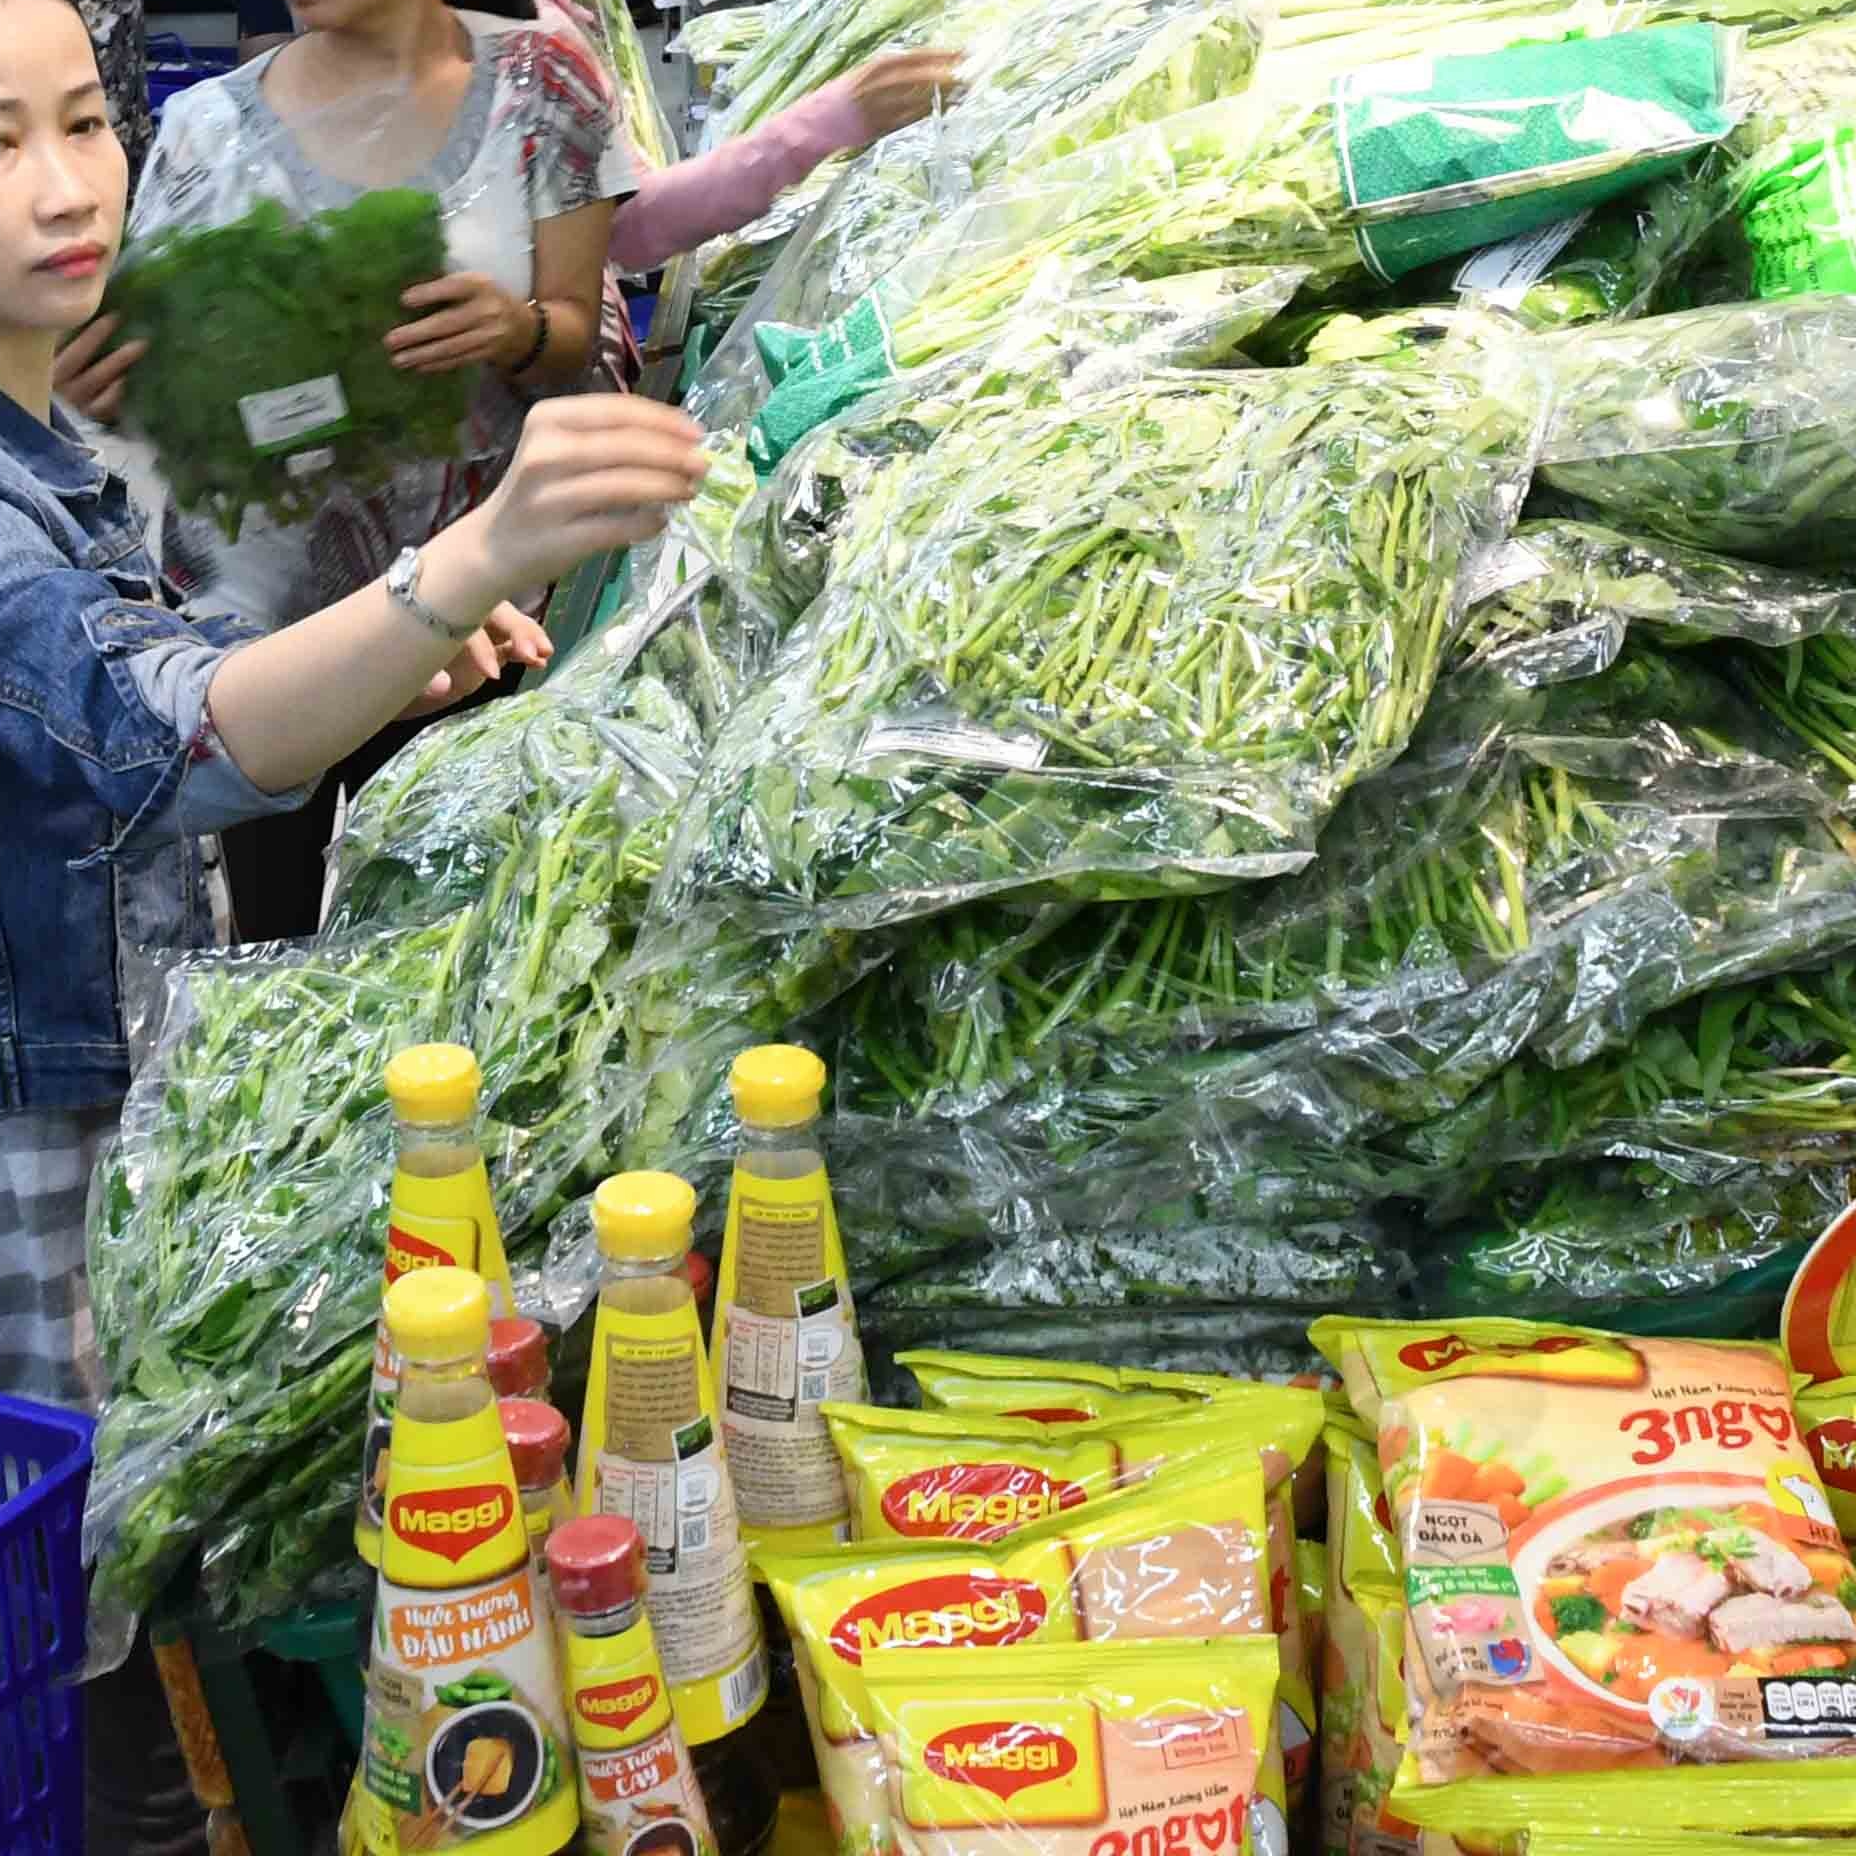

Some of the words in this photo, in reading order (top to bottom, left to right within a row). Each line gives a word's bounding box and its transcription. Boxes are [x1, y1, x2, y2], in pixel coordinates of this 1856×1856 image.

[398, 1493, 505, 1535] Maggi
[405, 1604, 455, 1630] Nước
[457, 1587, 520, 1624] Tương
[402, 1628, 456, 1665] ĐẬU
[460, 1606, 532, 1654] NÀNH
[578, 1681, 656, 1716] Maggi
[943, 1740, 1060, 1771] Maggi
[614, 1764, 661, 1799] CAY
